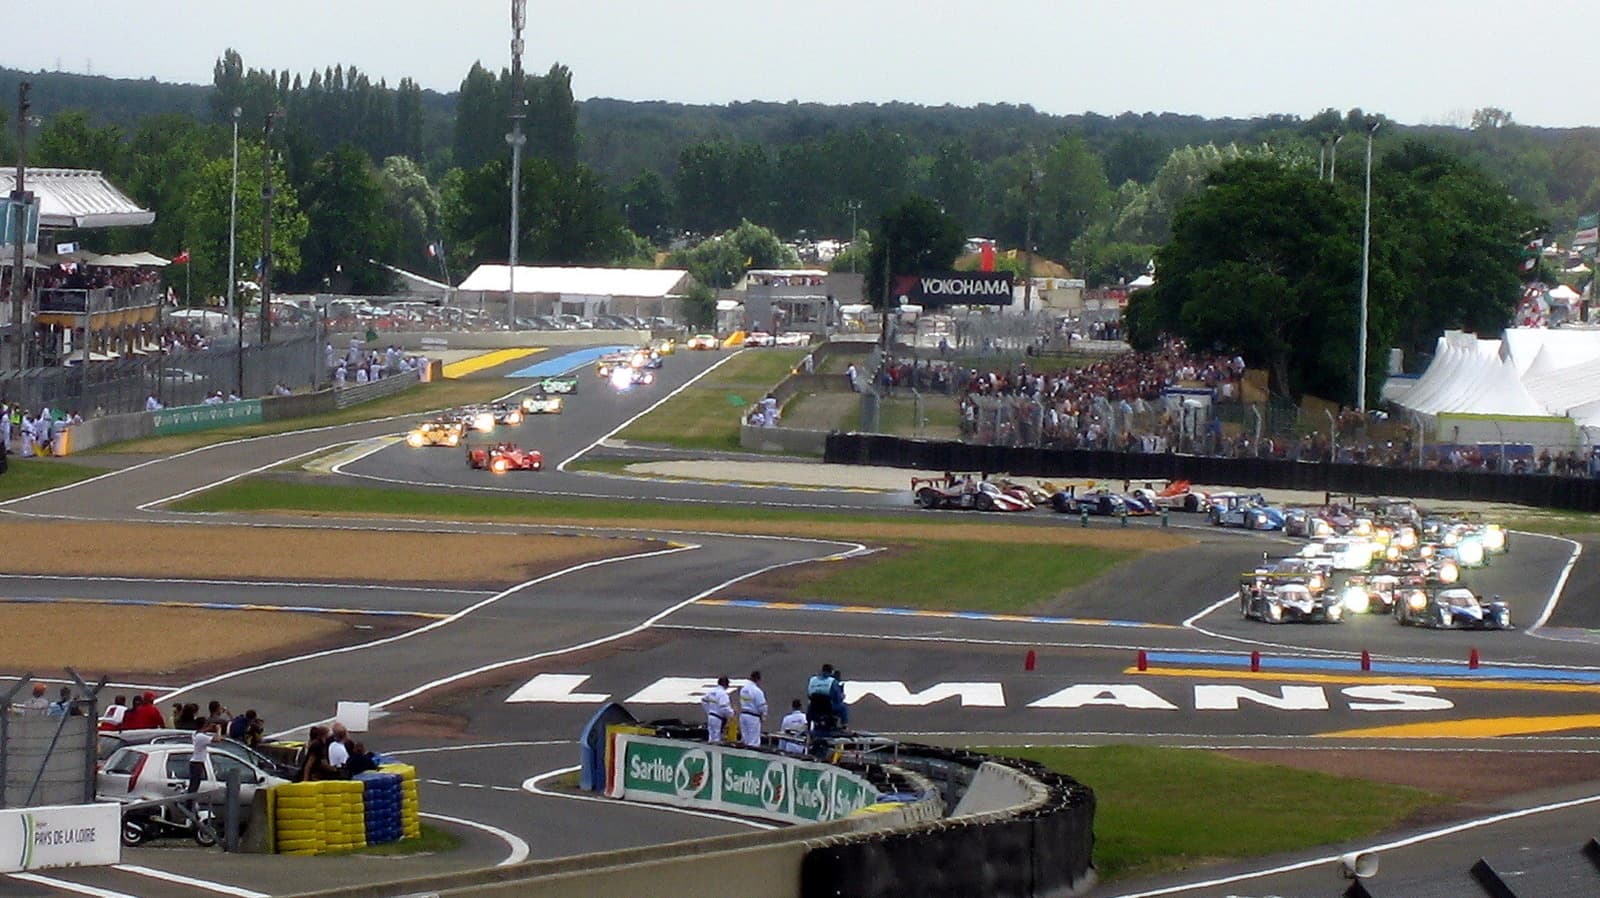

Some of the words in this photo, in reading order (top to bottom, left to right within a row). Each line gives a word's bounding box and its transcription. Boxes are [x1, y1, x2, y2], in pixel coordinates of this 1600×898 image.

[921, 278, 1010, 295] YOKOHAMA
[505, 673, 753, 704] LE
[838, 682, 1455, 711] MANS
[630, 754, 673, 783] Sarthe
[724, 765, 760, 796] Sarthe
[34, 831, 52, 846] PAYS
[53, 830, 64, 845] DE
[65, 829, 75, 844] LA
[75, 827, 96, 843] LOIRE
